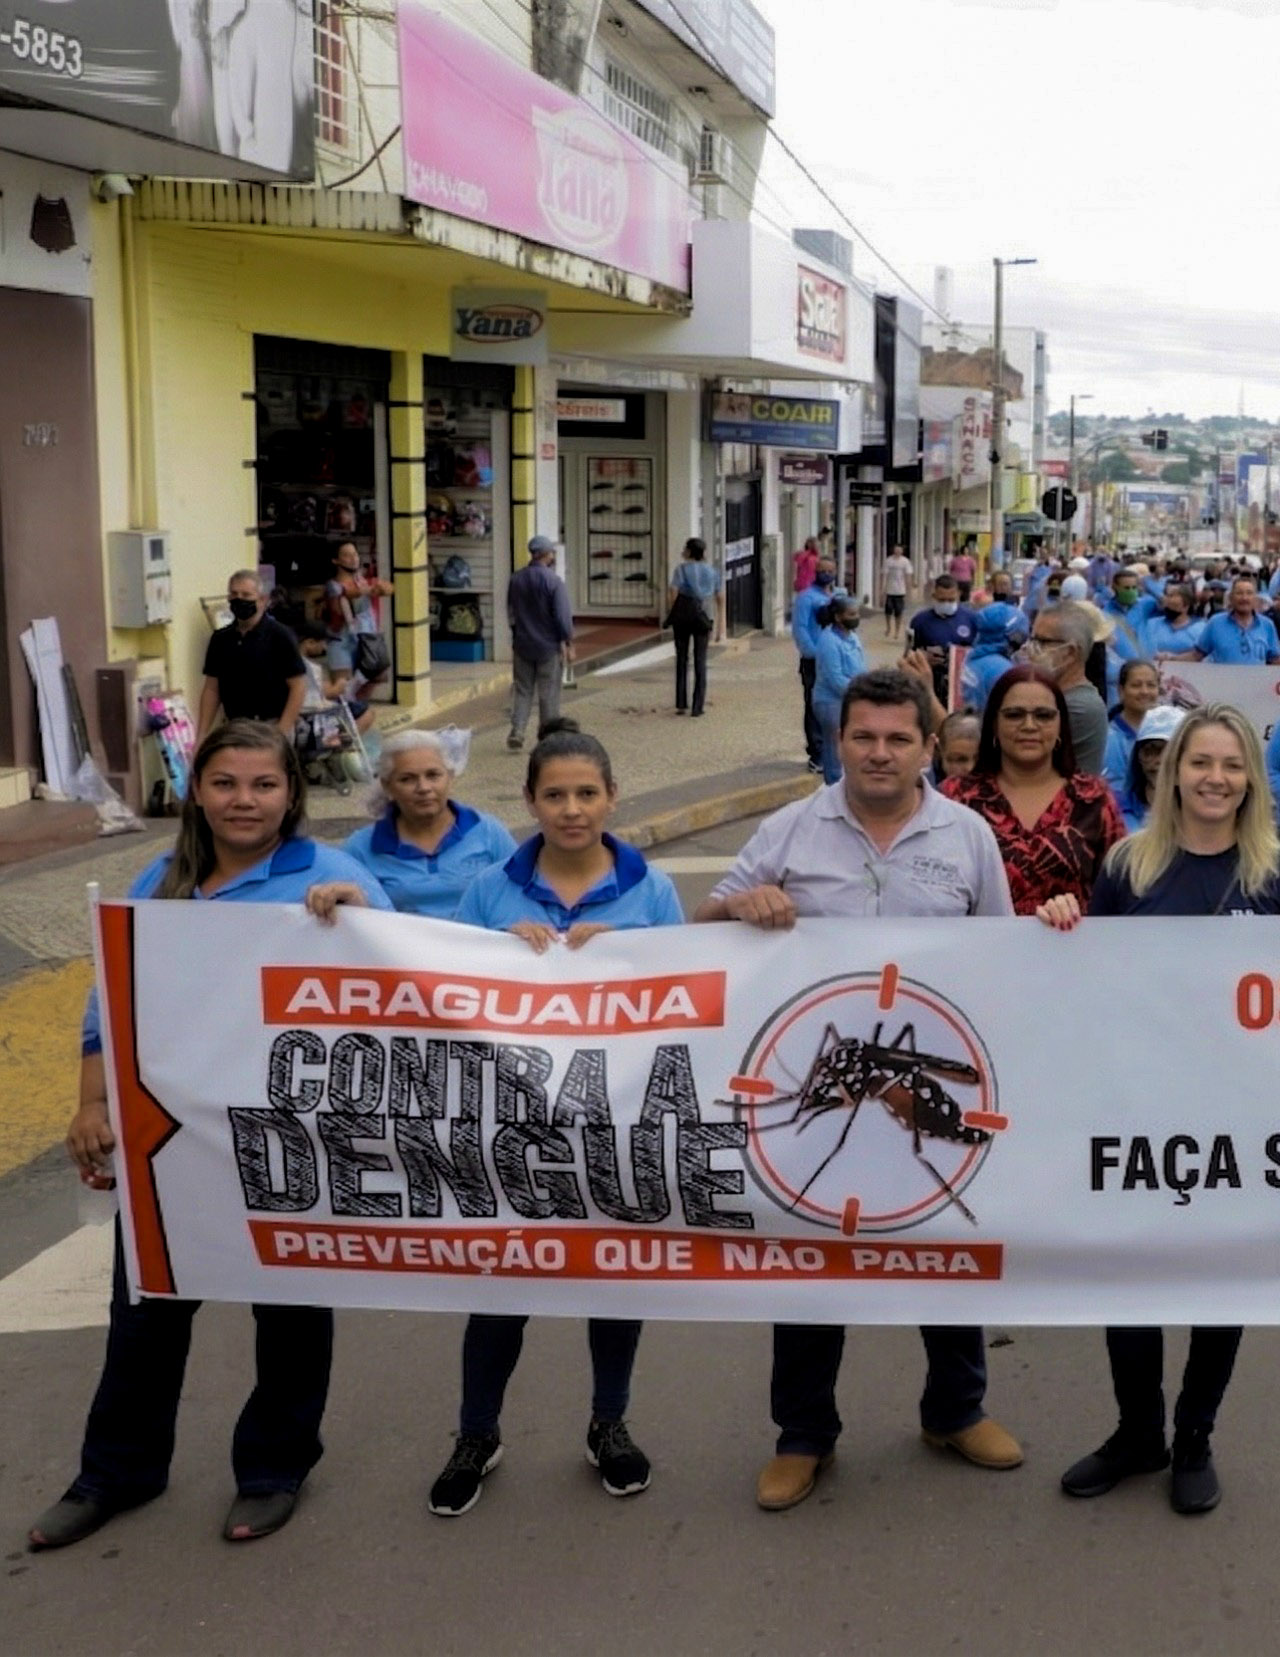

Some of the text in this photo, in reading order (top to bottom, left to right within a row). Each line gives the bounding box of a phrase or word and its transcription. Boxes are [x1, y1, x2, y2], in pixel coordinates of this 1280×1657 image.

[456, 308, 532, 337] Yana
[285, 977, 699, 1026] ARAGUAÍNA
[268, 1030, 701, 1128] CONTRA A
[228, 1106, 754, 1229] DENGUE
[1090, 1134, 1242, 1205] FAÇA
[273, 1230, 980, 1275] PREVENÇÃO QUE NÃO PARA
